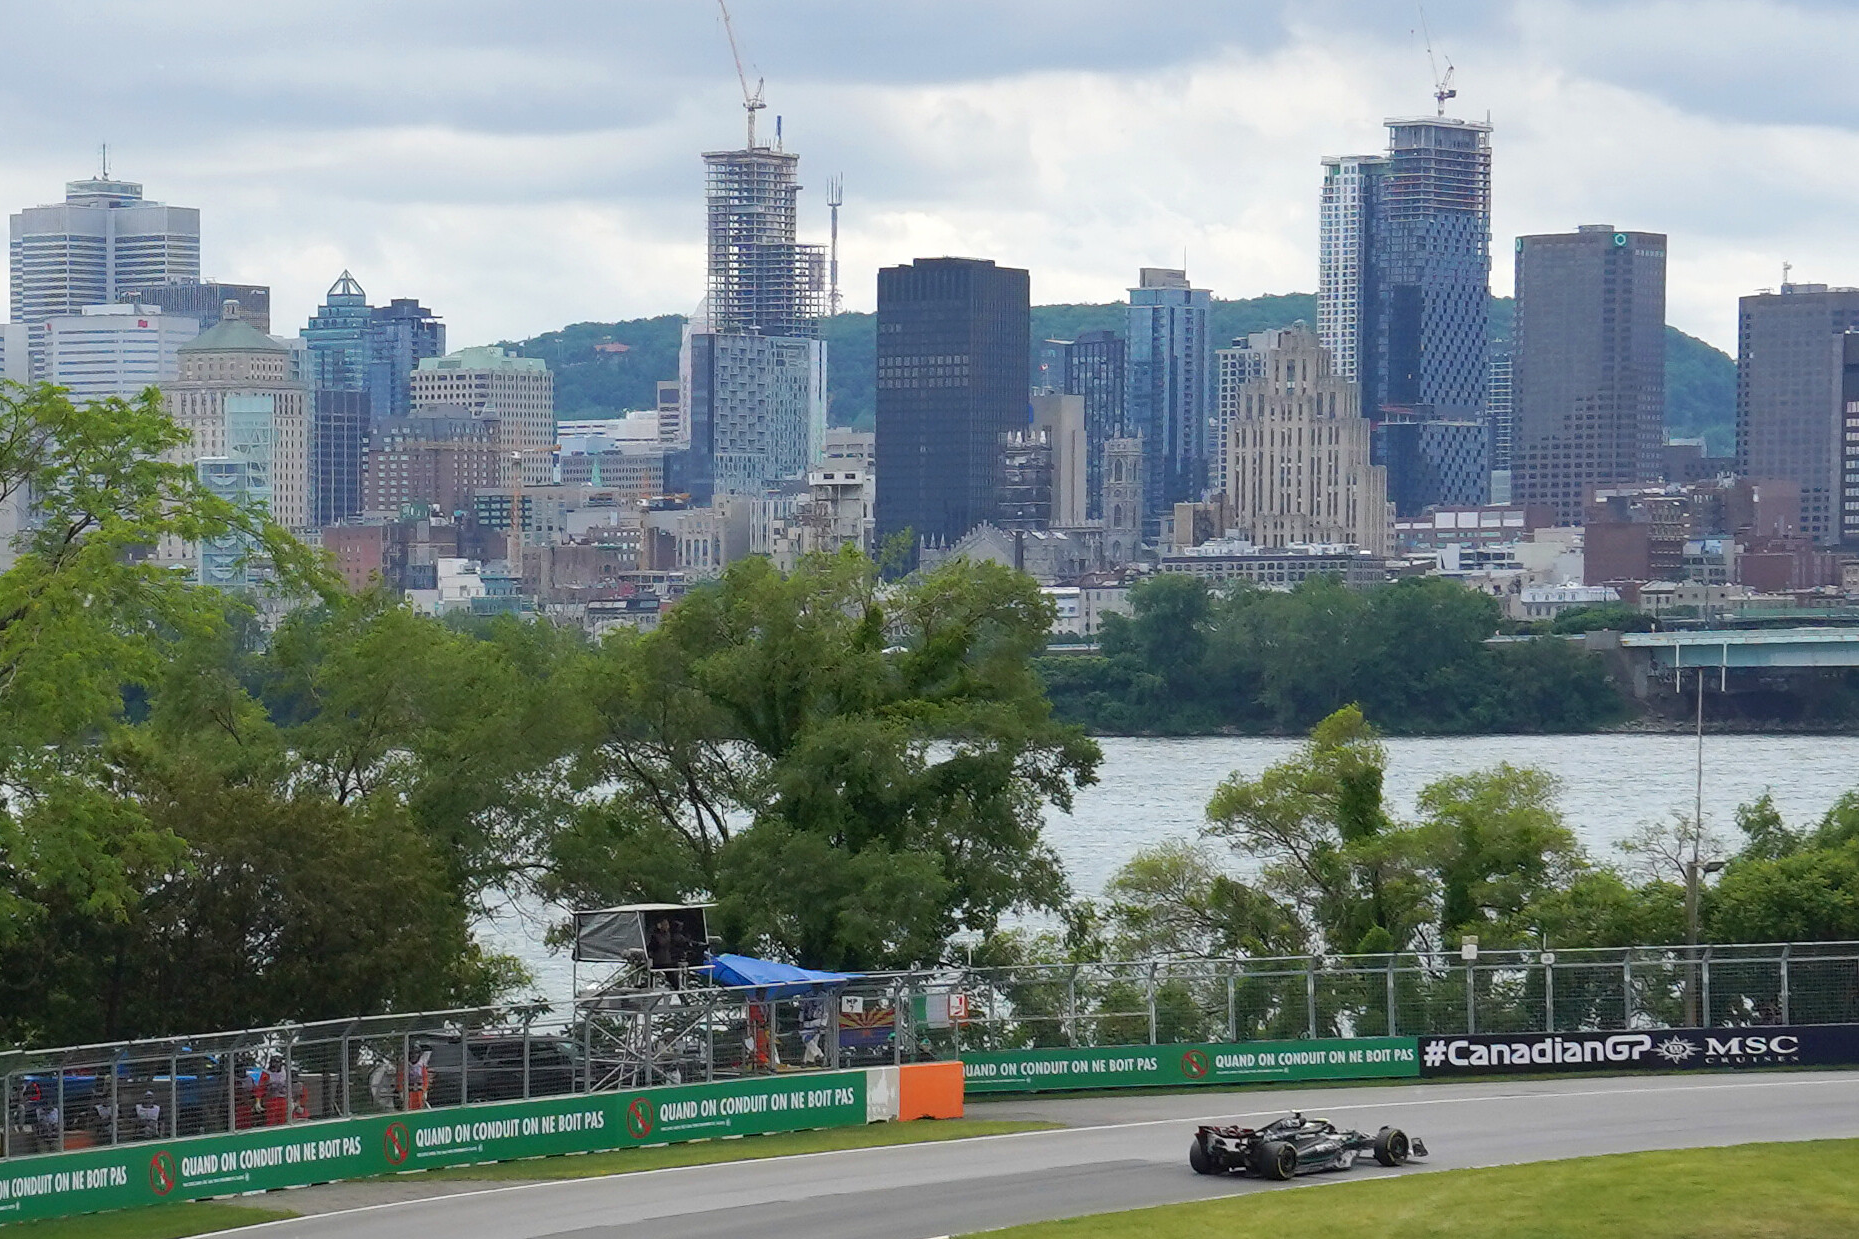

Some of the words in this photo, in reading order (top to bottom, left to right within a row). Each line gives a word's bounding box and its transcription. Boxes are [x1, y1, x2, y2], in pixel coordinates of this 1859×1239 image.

[1216, 1054, 1255, 1068] QUAND
[1258, 1053, 1275, 1066] ON
[1278, 1051, 1326, 1065] CONDUIT
[1329, 1051, 1345, 1063] ON
[1349, 1050, 1363, 1063] NE
[1366, 1049, 1391, 1062] BOIT
[1394, 1049, 1414, 1061] PAS
[1423, 1034, 1652, 1067] #CanadianGP
[1704, 1035, 1799, 1056] MSC
[1705, 1055, 1799, 1064] CRUISES
[1000, 1063, 1017, 1075] ON
[1021, 1061, 1069, 1075] CONDUIT
[1072, 1061, 1088, 1073] ON
[1092, 1060, 1106, 1072] NE
[1109, 1059, 1134, 1072] BOIT
[1137, 1058, 1157, 1070] PAS
[660, 1101, 697, 1122] QUAND
[701, 1099, 716, 1117] ON
[720, 1095, 768, 1115] CONDUIT
[771, 1094, 787, 1110] ON
[791, 1092, 804, 1109] NE
[808, 1090, 832, 1107] BOIT
[835, 1087, 854, 1105] PAS
[416, 1126, 452, 1147] QUAND
[455, 1124, 470, 1143] ON
[473, 1119, 519, 1140] CONDUIT
[523, 1117, 538, 1135] ON
[542, 1116, 555, 1134] NE
[559, 1113, 582, 1132] BOIT
[585, 1111, 604, 1129] PAS
[182, 1155, 218, 1176] QUAND
[221, 1152, 236, 1171] ON
[240, 1146, 283, 1169] CONDUIT
[286, 1144, 300, 1163] ON
[304, 1142, 316, 1161] NE
[319, 1139, 341, 1159] BOIT
[343, 1137, 361, 1155] PAS
[12, 1174, 52, 1197] CONDUIT
[55, 1173, 69, 1192] ON
[72, 1171, 84, 1190] NE
[87, 1168, 108, 1188] BOIT
[110, 1166, 127, 1185] PAS
